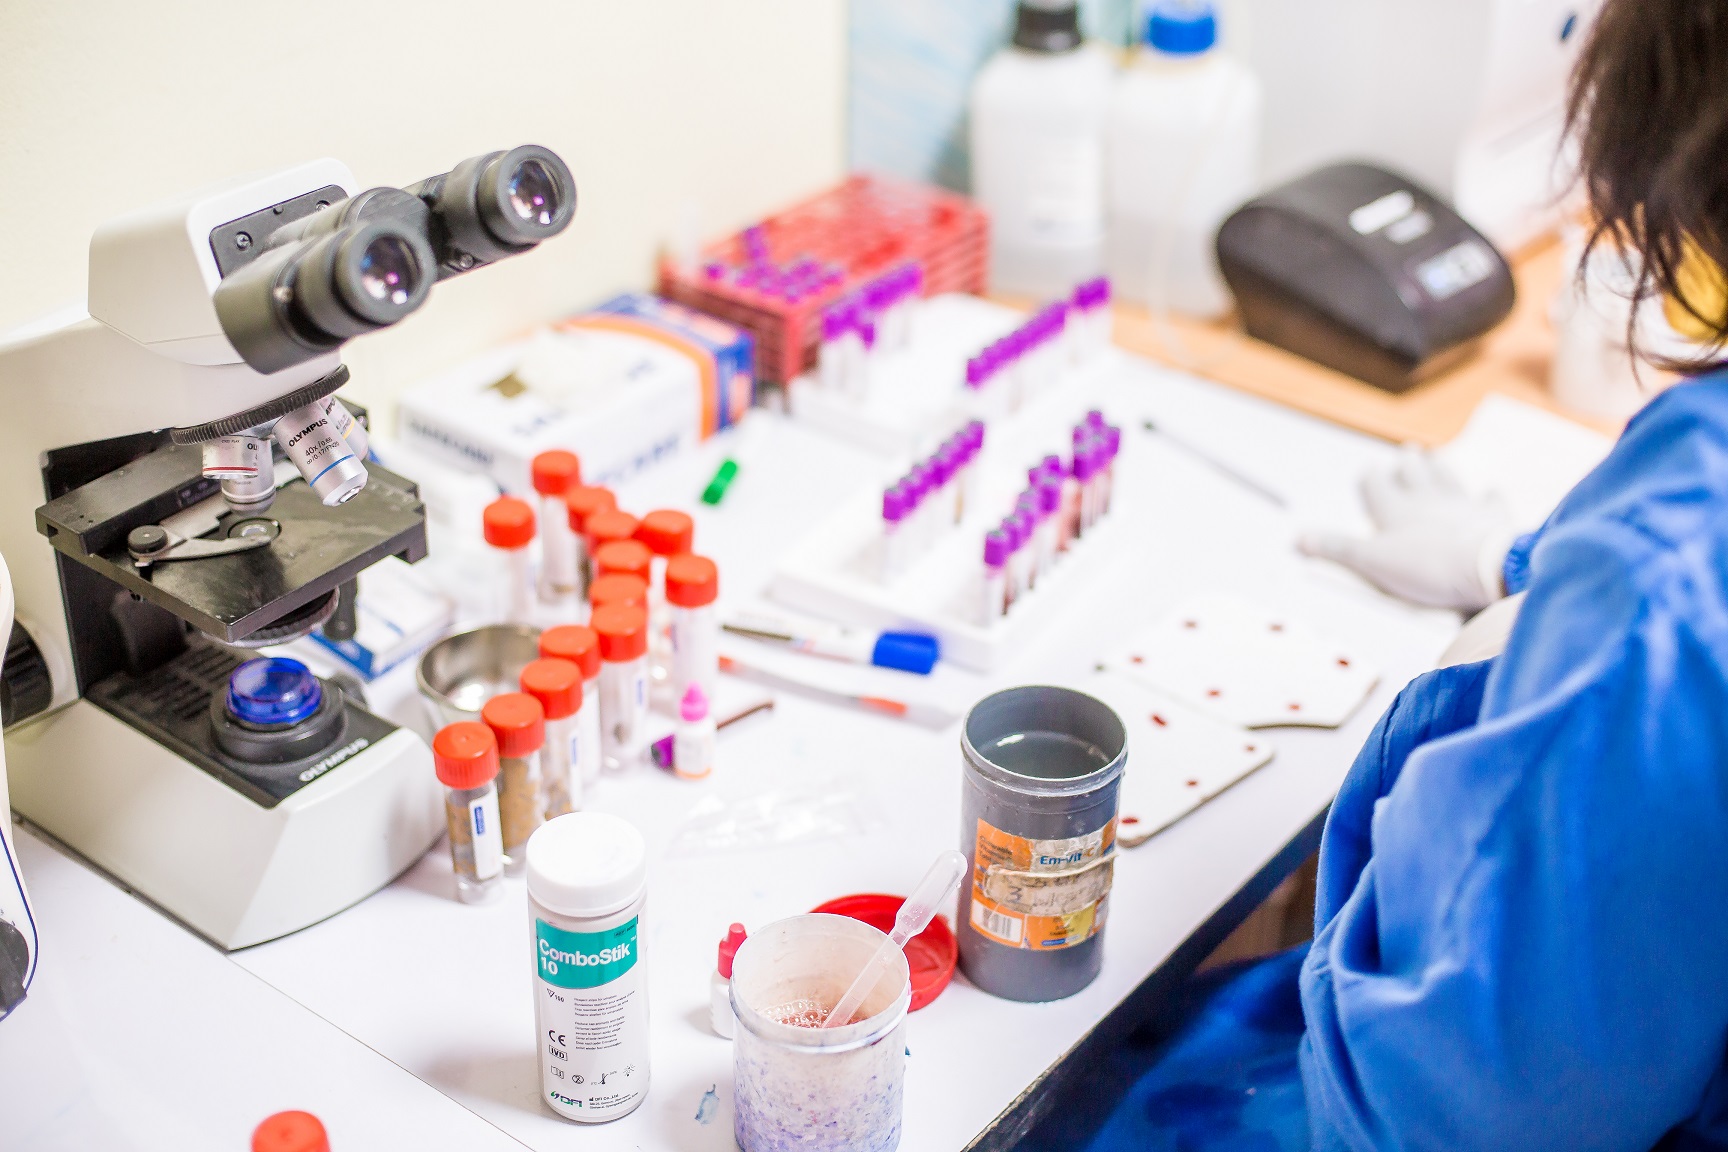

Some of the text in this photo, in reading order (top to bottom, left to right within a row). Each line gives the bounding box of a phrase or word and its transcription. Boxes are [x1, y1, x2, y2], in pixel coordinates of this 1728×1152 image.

[288, 418, 328, 448] OLYMPUS
[299, 737, 369, 782] OLYMPUS
[540, 957, 559, 976] 10
[549, 1029, 566, 1047] CE
[550, 1047, 566, 1060] IVD
